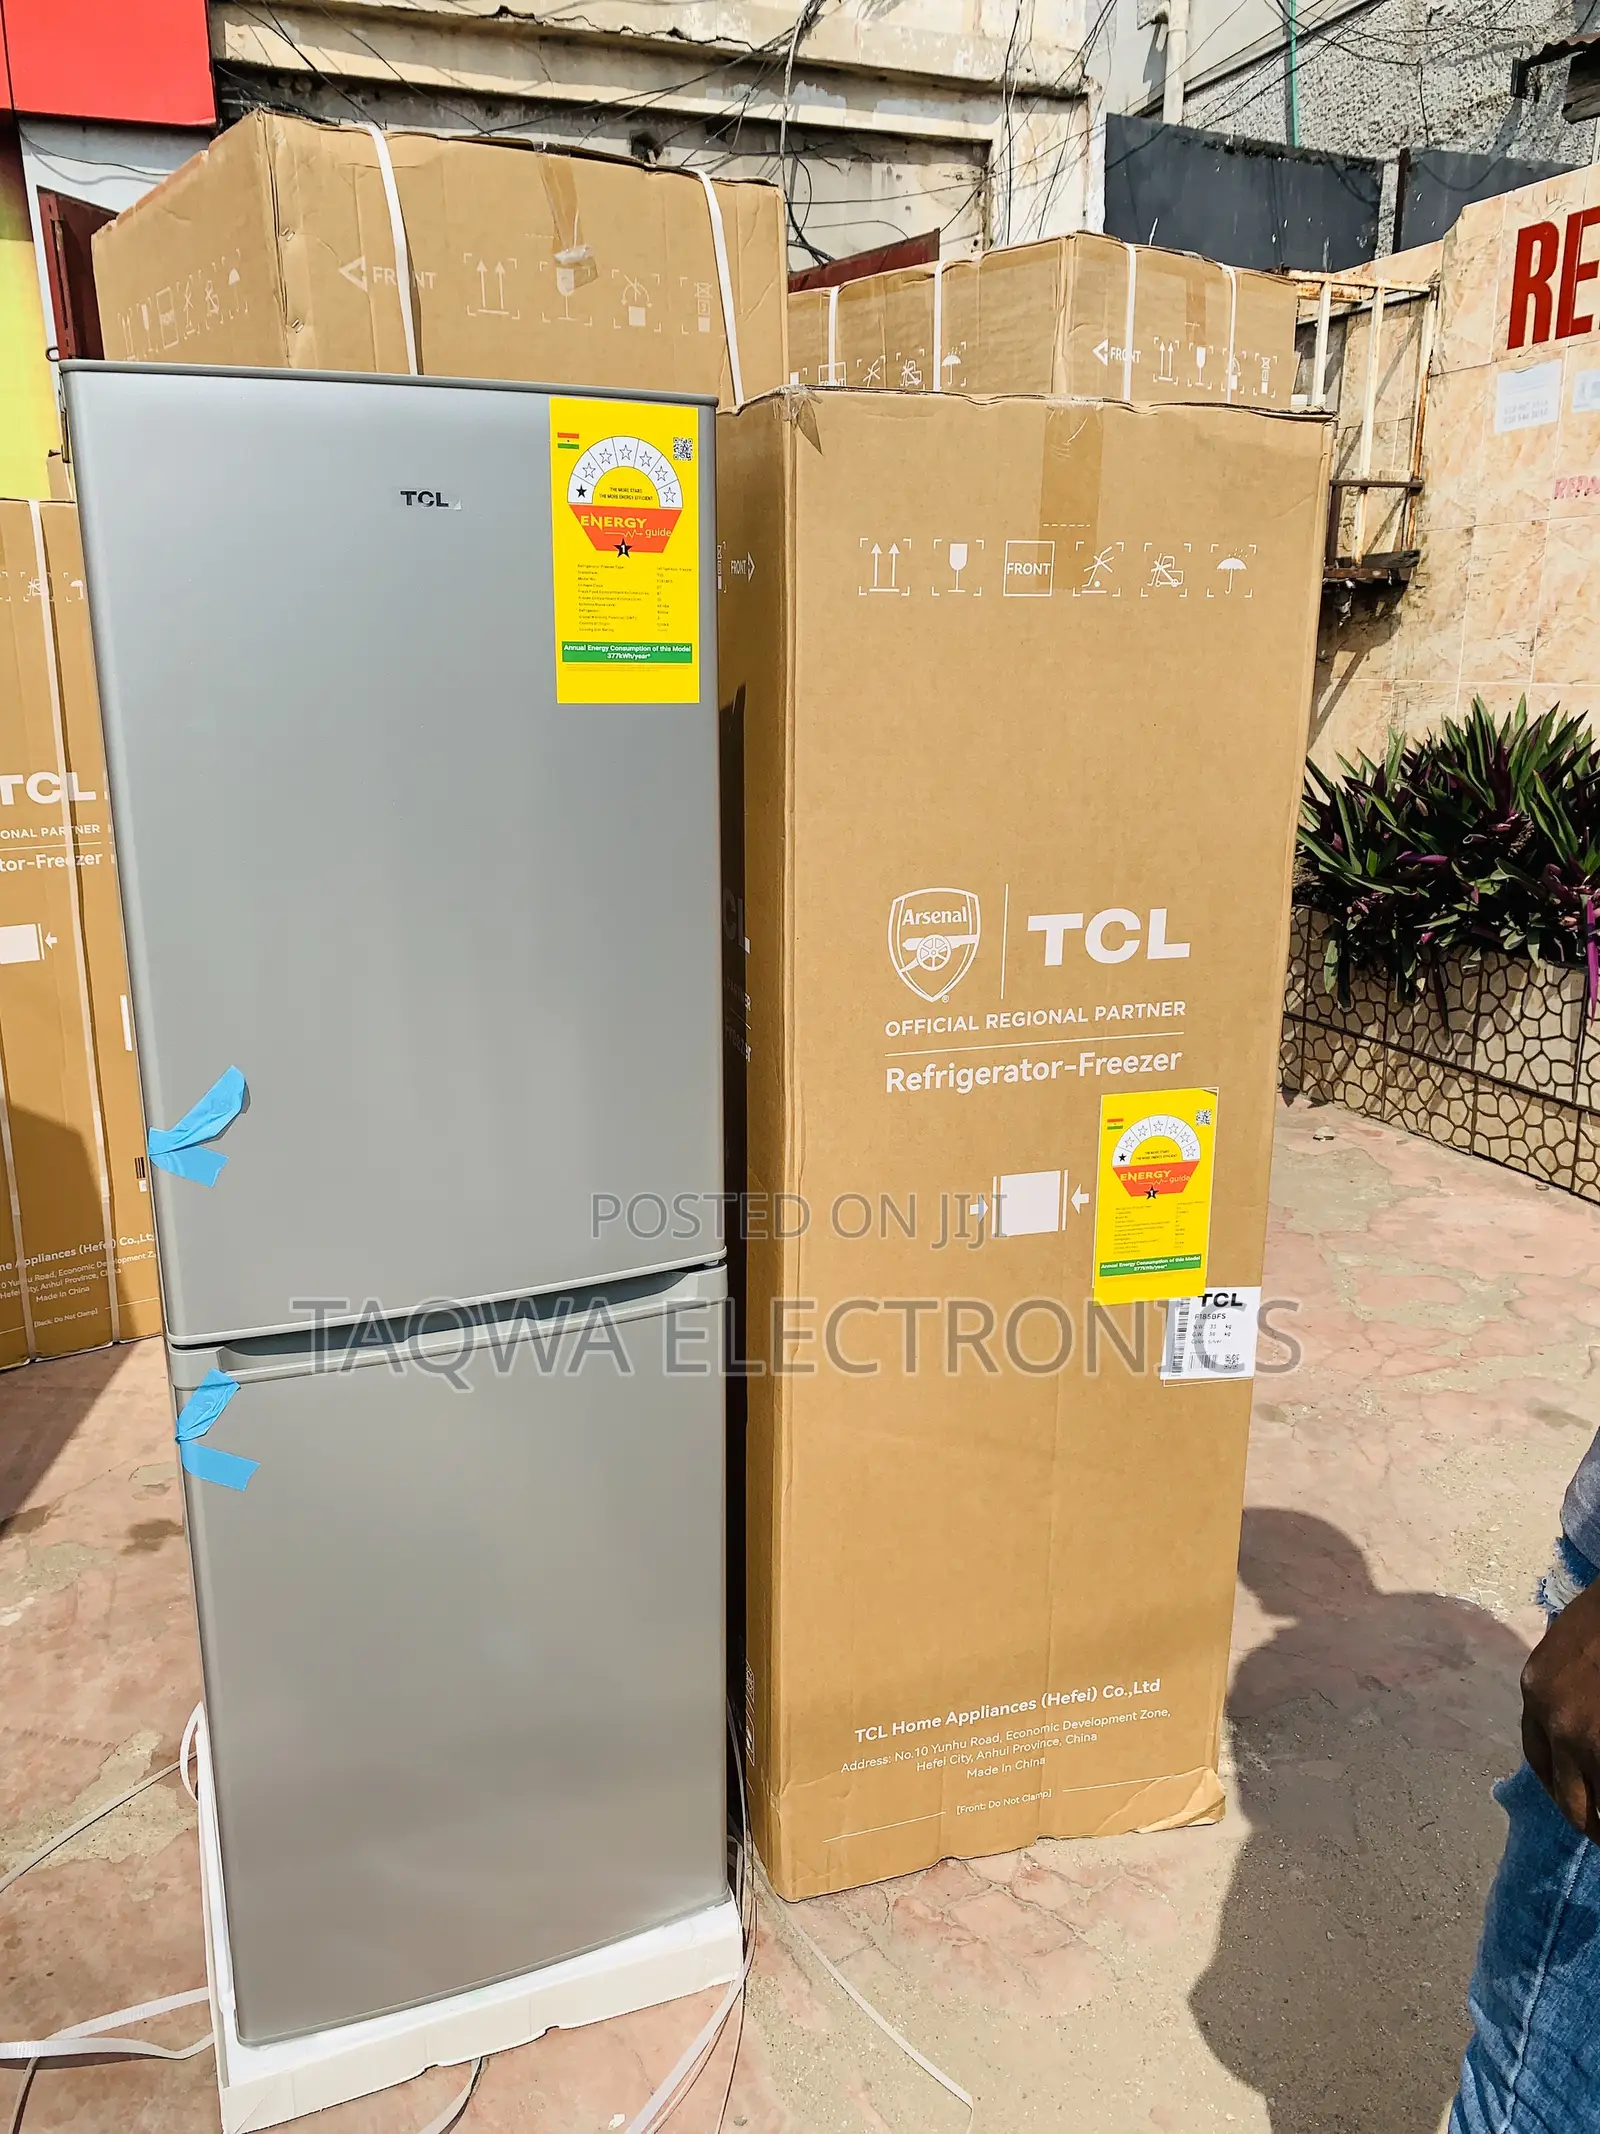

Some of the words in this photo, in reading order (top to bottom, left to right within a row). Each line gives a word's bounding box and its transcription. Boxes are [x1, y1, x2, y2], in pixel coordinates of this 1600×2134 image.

[372, 266, 436, 290] FRNT
[400, 490, 450, 508] TCL
[580, 512, 647, 531] ENERGY
[645, 528, 672, 538] guide
[620, 544, 626, 554] 1
[1006, 562, 1051, 576] FRONT
[901, 906, 968, 926] Arsenal
[1027, 907, 1190, 966] TCL
[884, 1015, 979, 1038] OFFICIAL
[985, 1007, 1089, 1030] REGIONAL
[1094, 1000, 1186, 1022] PARTNER
[885, 1051, 1183, 1094] Refrigerator-Freezer
[1120, 1170, 1172, 1183] ENERGY
[1169, 1175, 1191, 1184] guide
[68, 1286, 90, 1295] China
[1197, 1292, 1243, 1308] TCL
[854, 1725, 888, 1743] TCL
[892, 1716, 942, 1735] Home
[945, 1699, 1037, 1726] Appliances
[1041, 1686, 1098, 1708] (Hefei)
[1102, 1678, 1161, 1699] Co.,Ltd
[840, 1755, 891, 1773] Address:
[894, 1746, 928, 1762] No.10
[931, 1740, 966, 1754] Yunhu
[970, 1732, 1002, 1747] Road,
[1006, 1722, 1060, 1741] Economic
[1062, 1712, 1137, 1730] Development
[1140, 1708, 1171, 1720] Zone,
[917, 1756, 946, 1772] Hefei
[950, 1754, 973, 1765] City,
[976, 1748, 1009, 1760] Anhui
[1012, 1738, 1062, 1754] Province,
[1066, 1733, 1097, 1745] China
[966, 1766, 999, 1779] Made
[1015, 1757, 1046, 1770] China
[988, 1800, 1001, 1809] Do
[1004, 1796, 1020, 1806] Not
[1022, 1789, 1052, 1802] Clamp]
